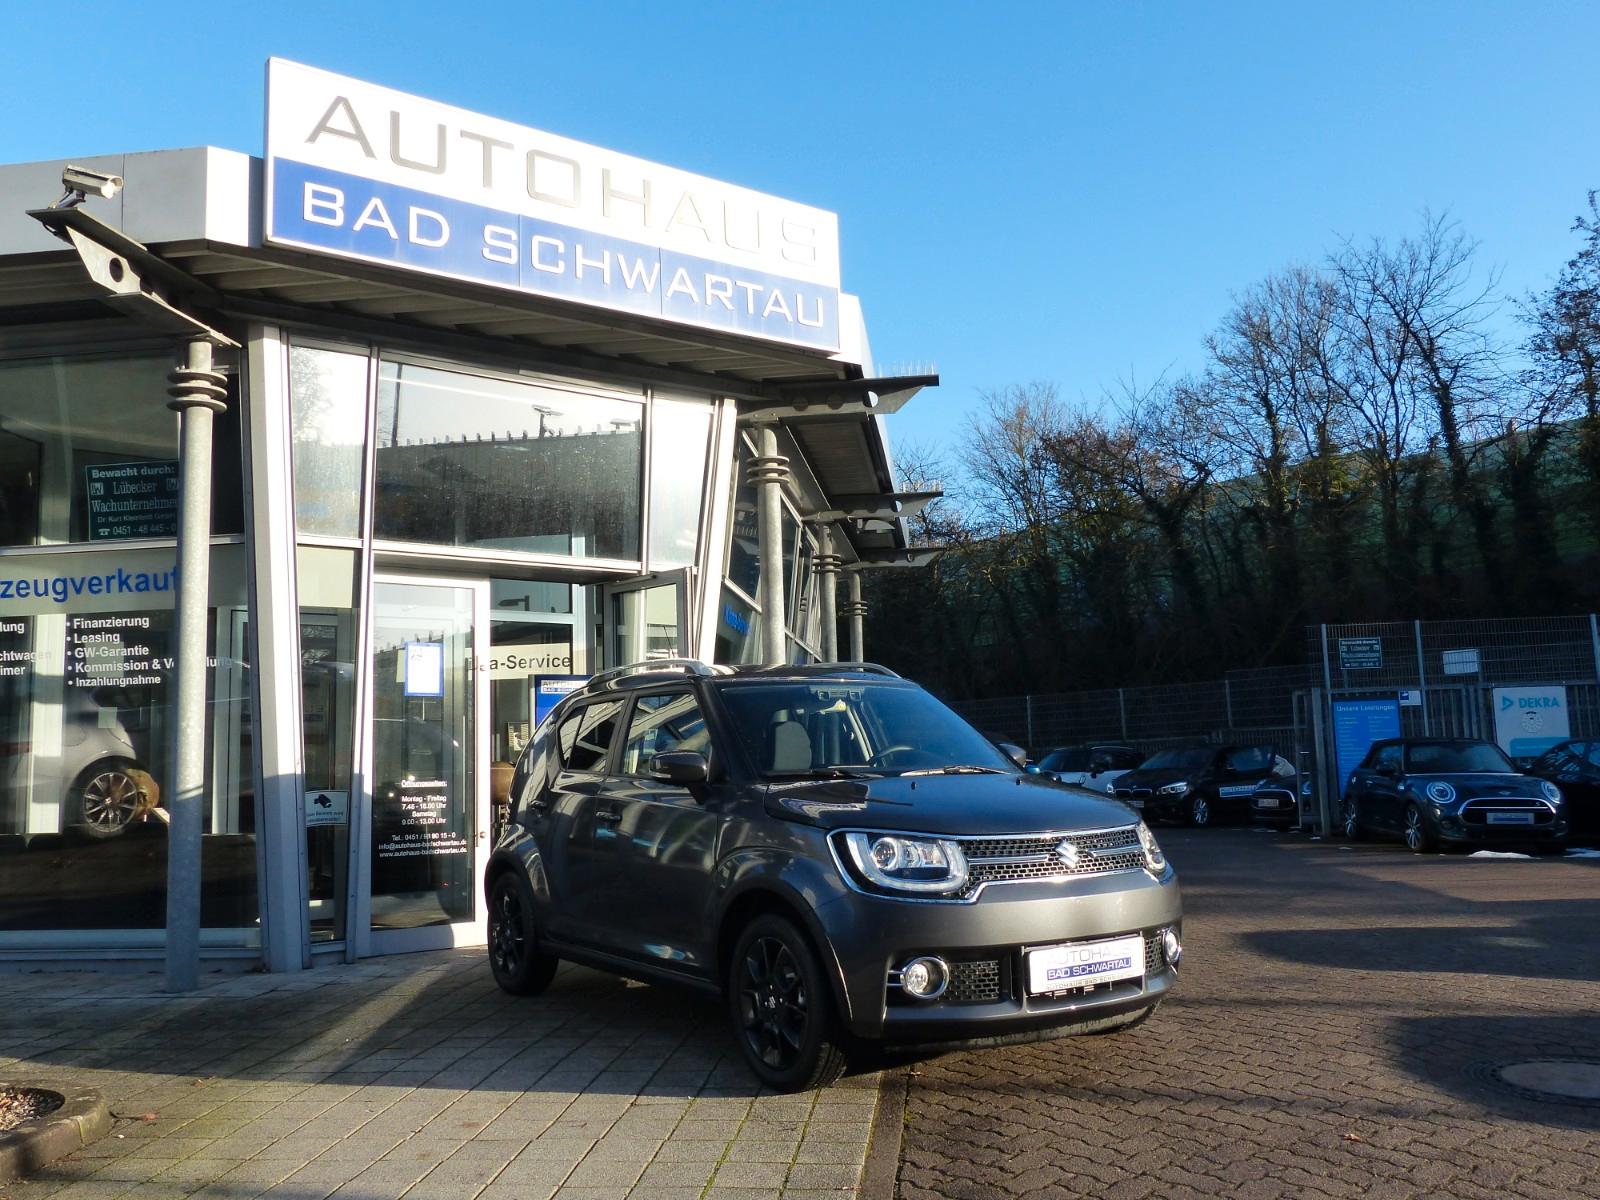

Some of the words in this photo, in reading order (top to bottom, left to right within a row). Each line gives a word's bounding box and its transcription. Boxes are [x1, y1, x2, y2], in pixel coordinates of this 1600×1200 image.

[304, 95, 817, 268] AUTOHAUS
[303, 181, 450, 248] BAD
[481, 224, 824, 328] SCHWARTAU
[91, 467, 138, 479] Bewacht
[140, 465, 175, 476] durch:
[112, 480, 157, 495] Lübecker
[73, 617, 150, 630] Finanzierung
[74, 632, 120, 644] Leasing
[74, 645, 149, 659] GW-Garantie
[75, 660, 149, 673] Kommission
[152, 658, 161, 670] &
[76, 675, 161, 687] Inzahlungnahme
[1518, 696, 1561, 709] DEKRA
[1048, 968, 1070, 979] BAD
[1073, 959, 1131, 976] SCHWARTAU
